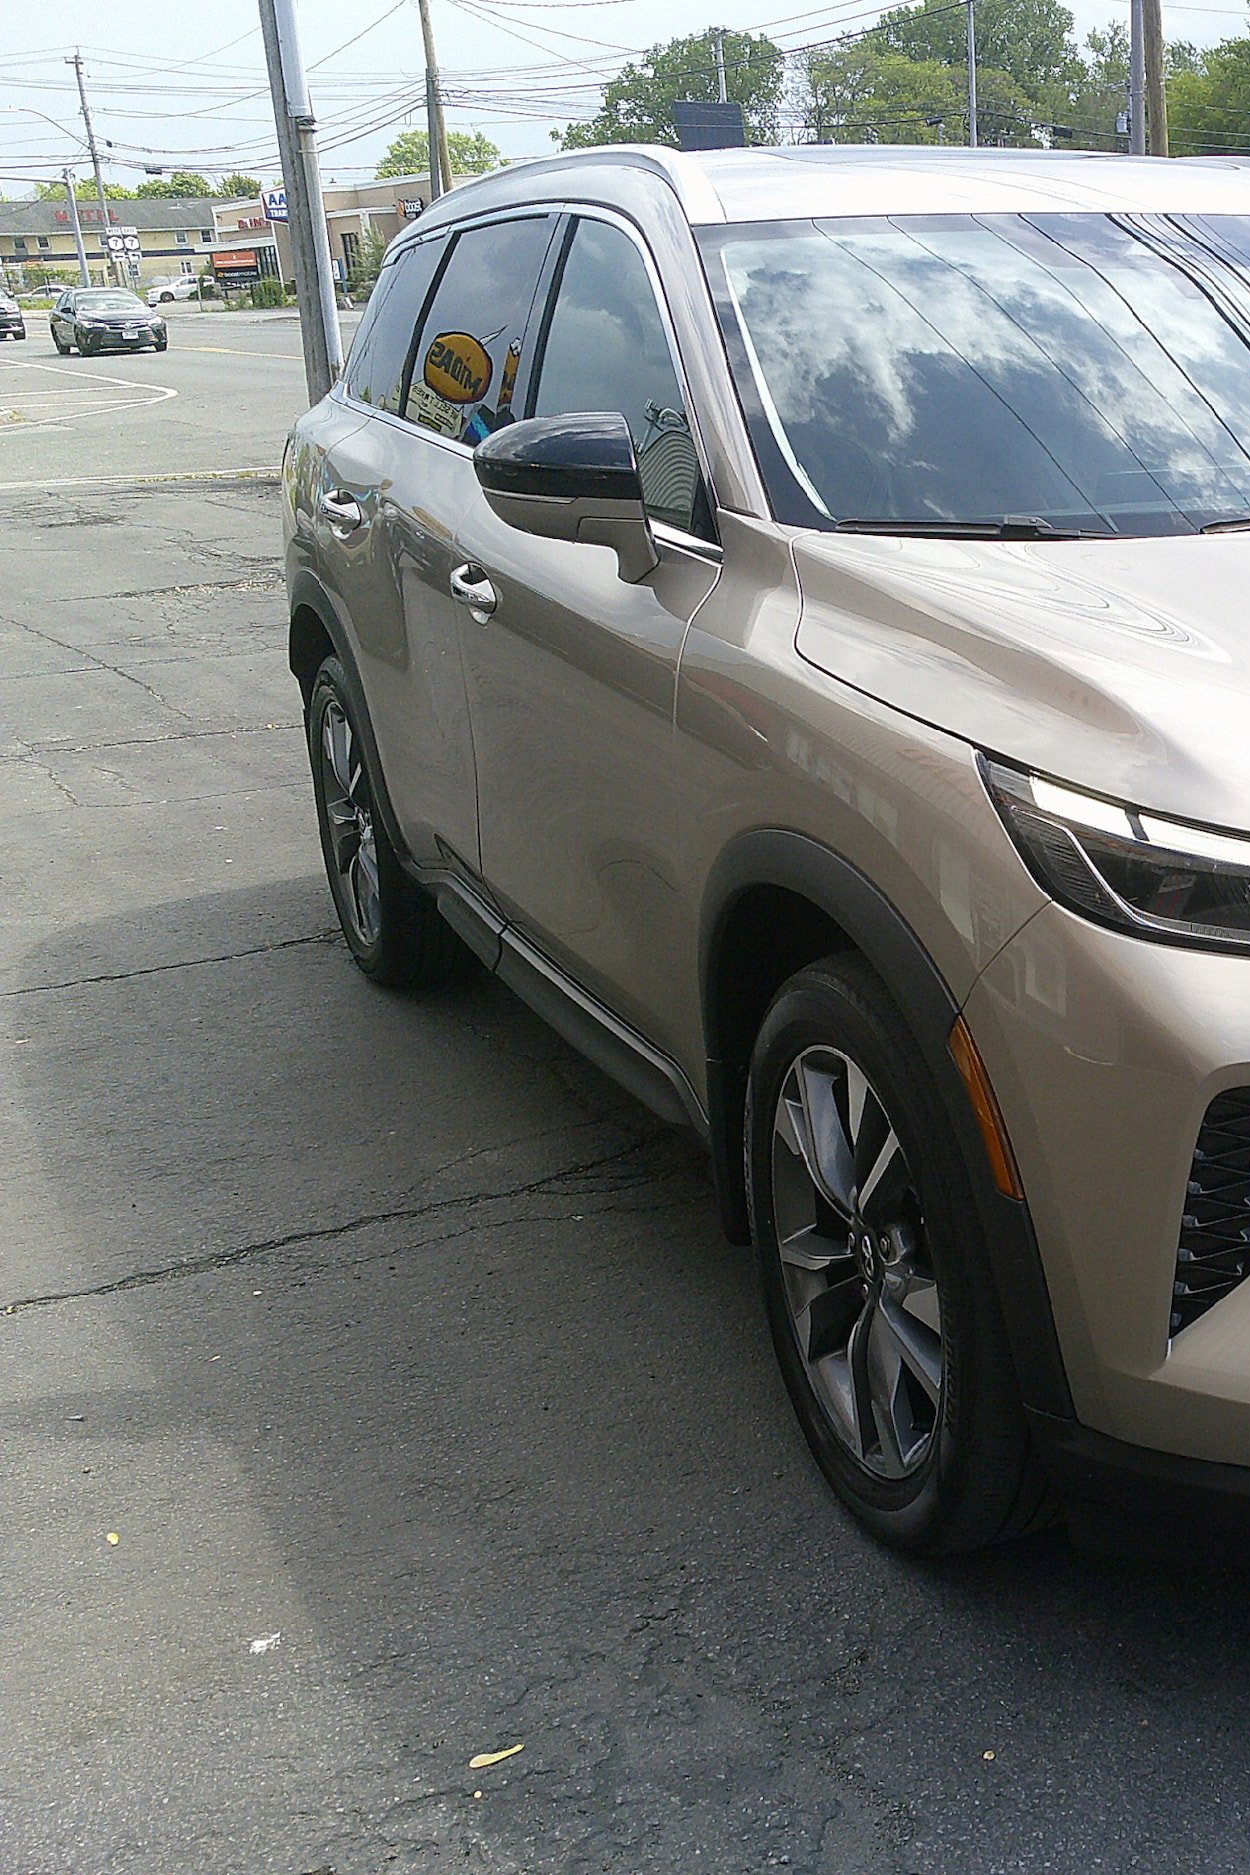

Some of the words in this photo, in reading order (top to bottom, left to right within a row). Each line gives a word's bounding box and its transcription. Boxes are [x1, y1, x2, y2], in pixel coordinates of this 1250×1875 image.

[268, 193, 288, 206] AA
[404, 199, 423, 213] boost
[53, 208, 119, 222] MTEL
[112, 239, 119, 248] 7
[128, 239, 135, 248] 7
